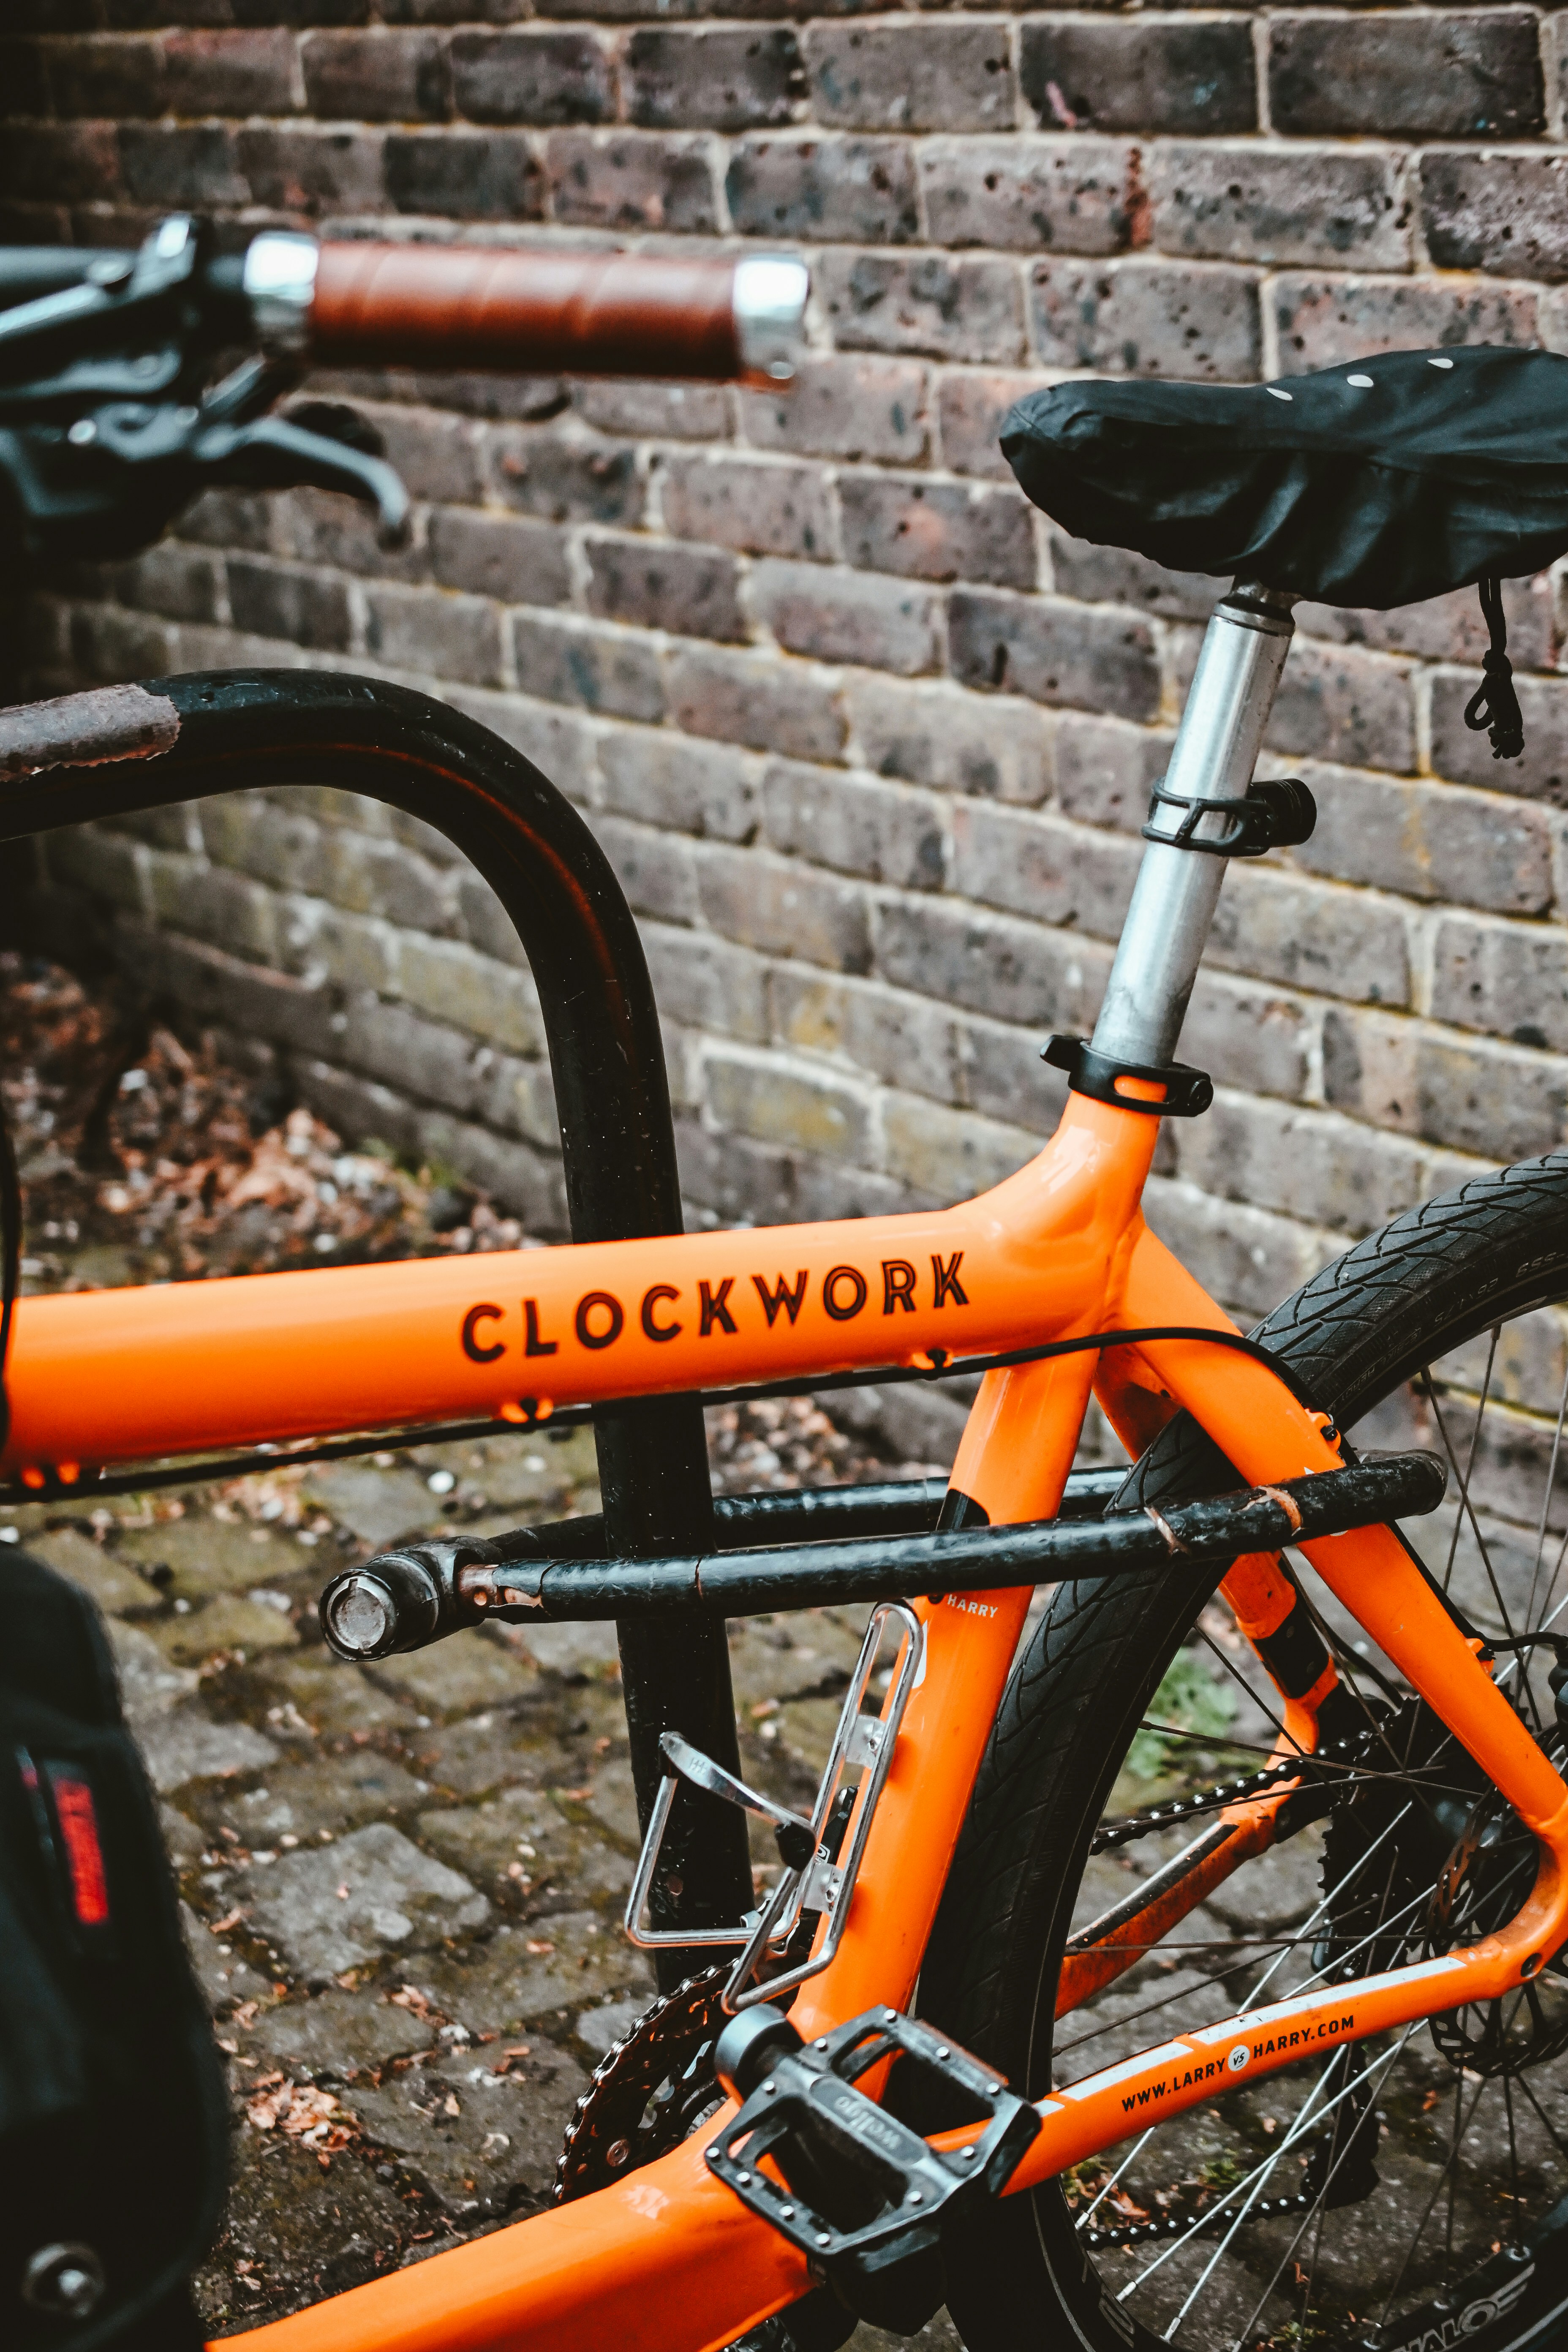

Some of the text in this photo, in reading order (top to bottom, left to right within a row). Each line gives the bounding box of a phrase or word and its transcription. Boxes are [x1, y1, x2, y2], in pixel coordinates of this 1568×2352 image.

[1515, 1252, 1568, 1278] -559
[460, 1251, 969, 1364] CLOCKWORK
[947, 1594, 998, 1618] HARRY
[1122, 2015, 1354, 2112] WWW.LARRY VS HARRY.COM
